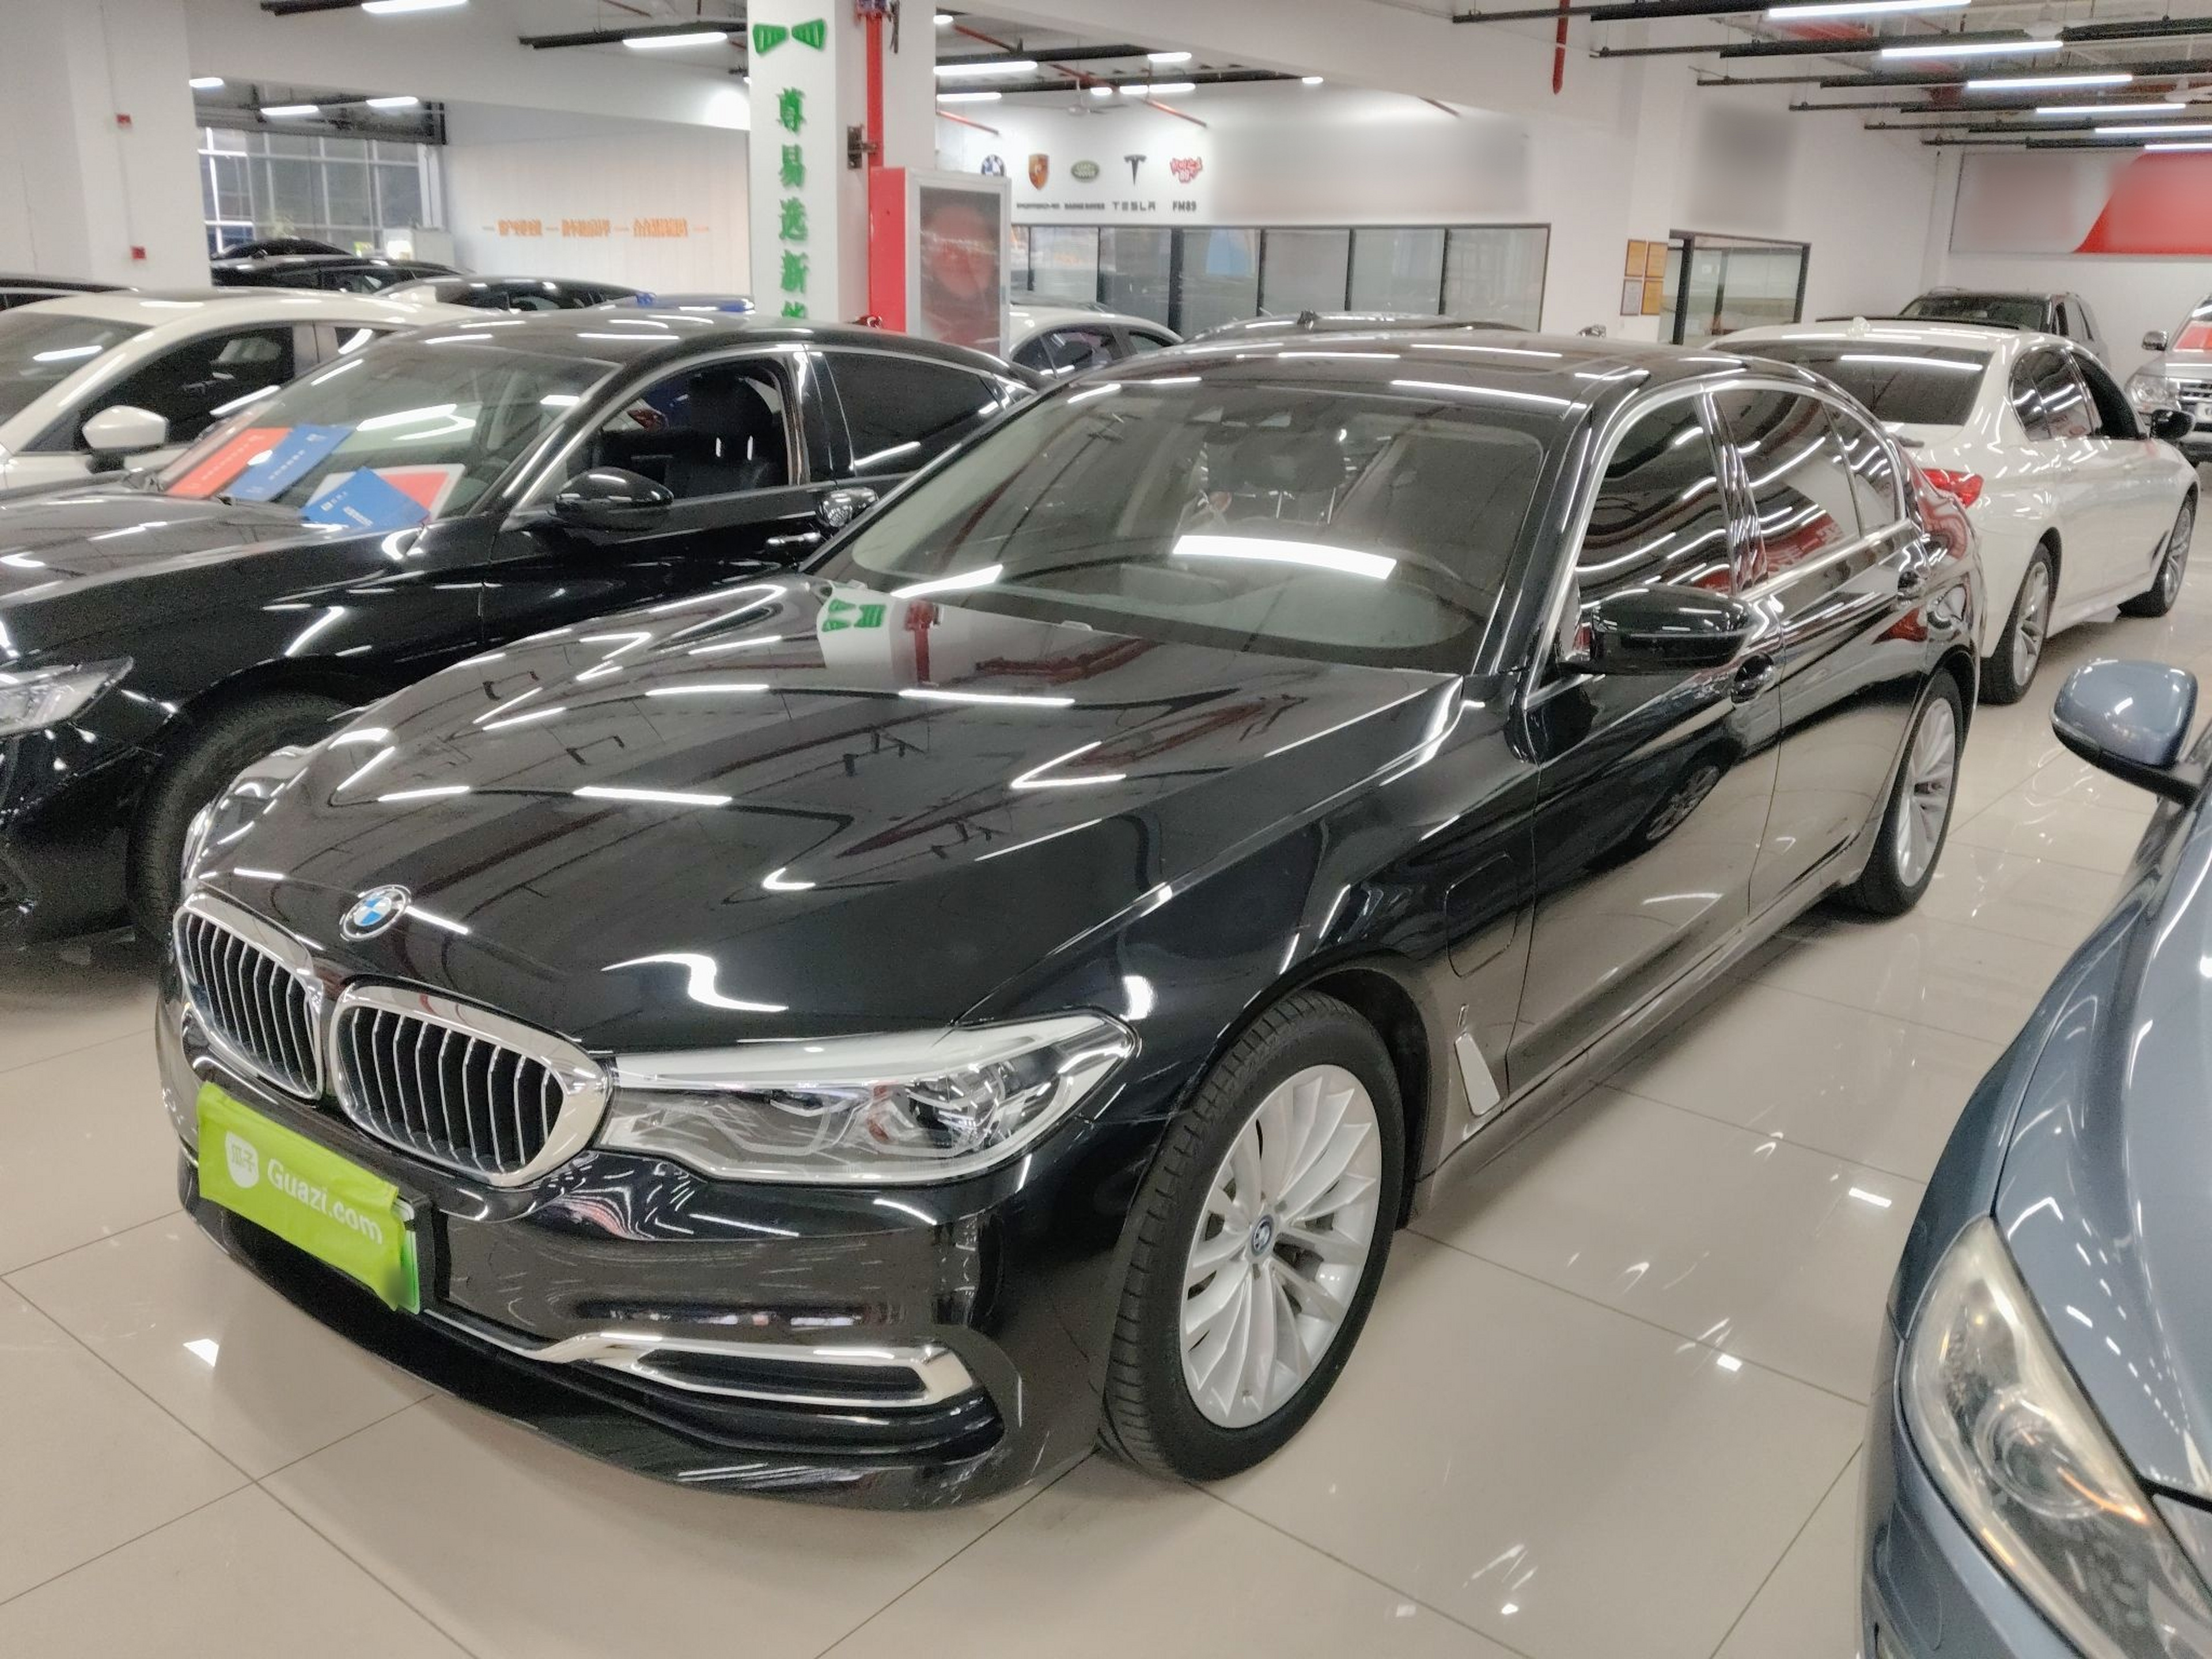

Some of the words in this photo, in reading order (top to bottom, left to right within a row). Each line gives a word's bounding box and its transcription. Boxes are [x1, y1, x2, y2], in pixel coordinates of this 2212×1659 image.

[1112, 201, 1156, 211] TESLA
[1172, 200, 1196, 211] FM89
[267, 1158, 383, 1245] Guazi.com
